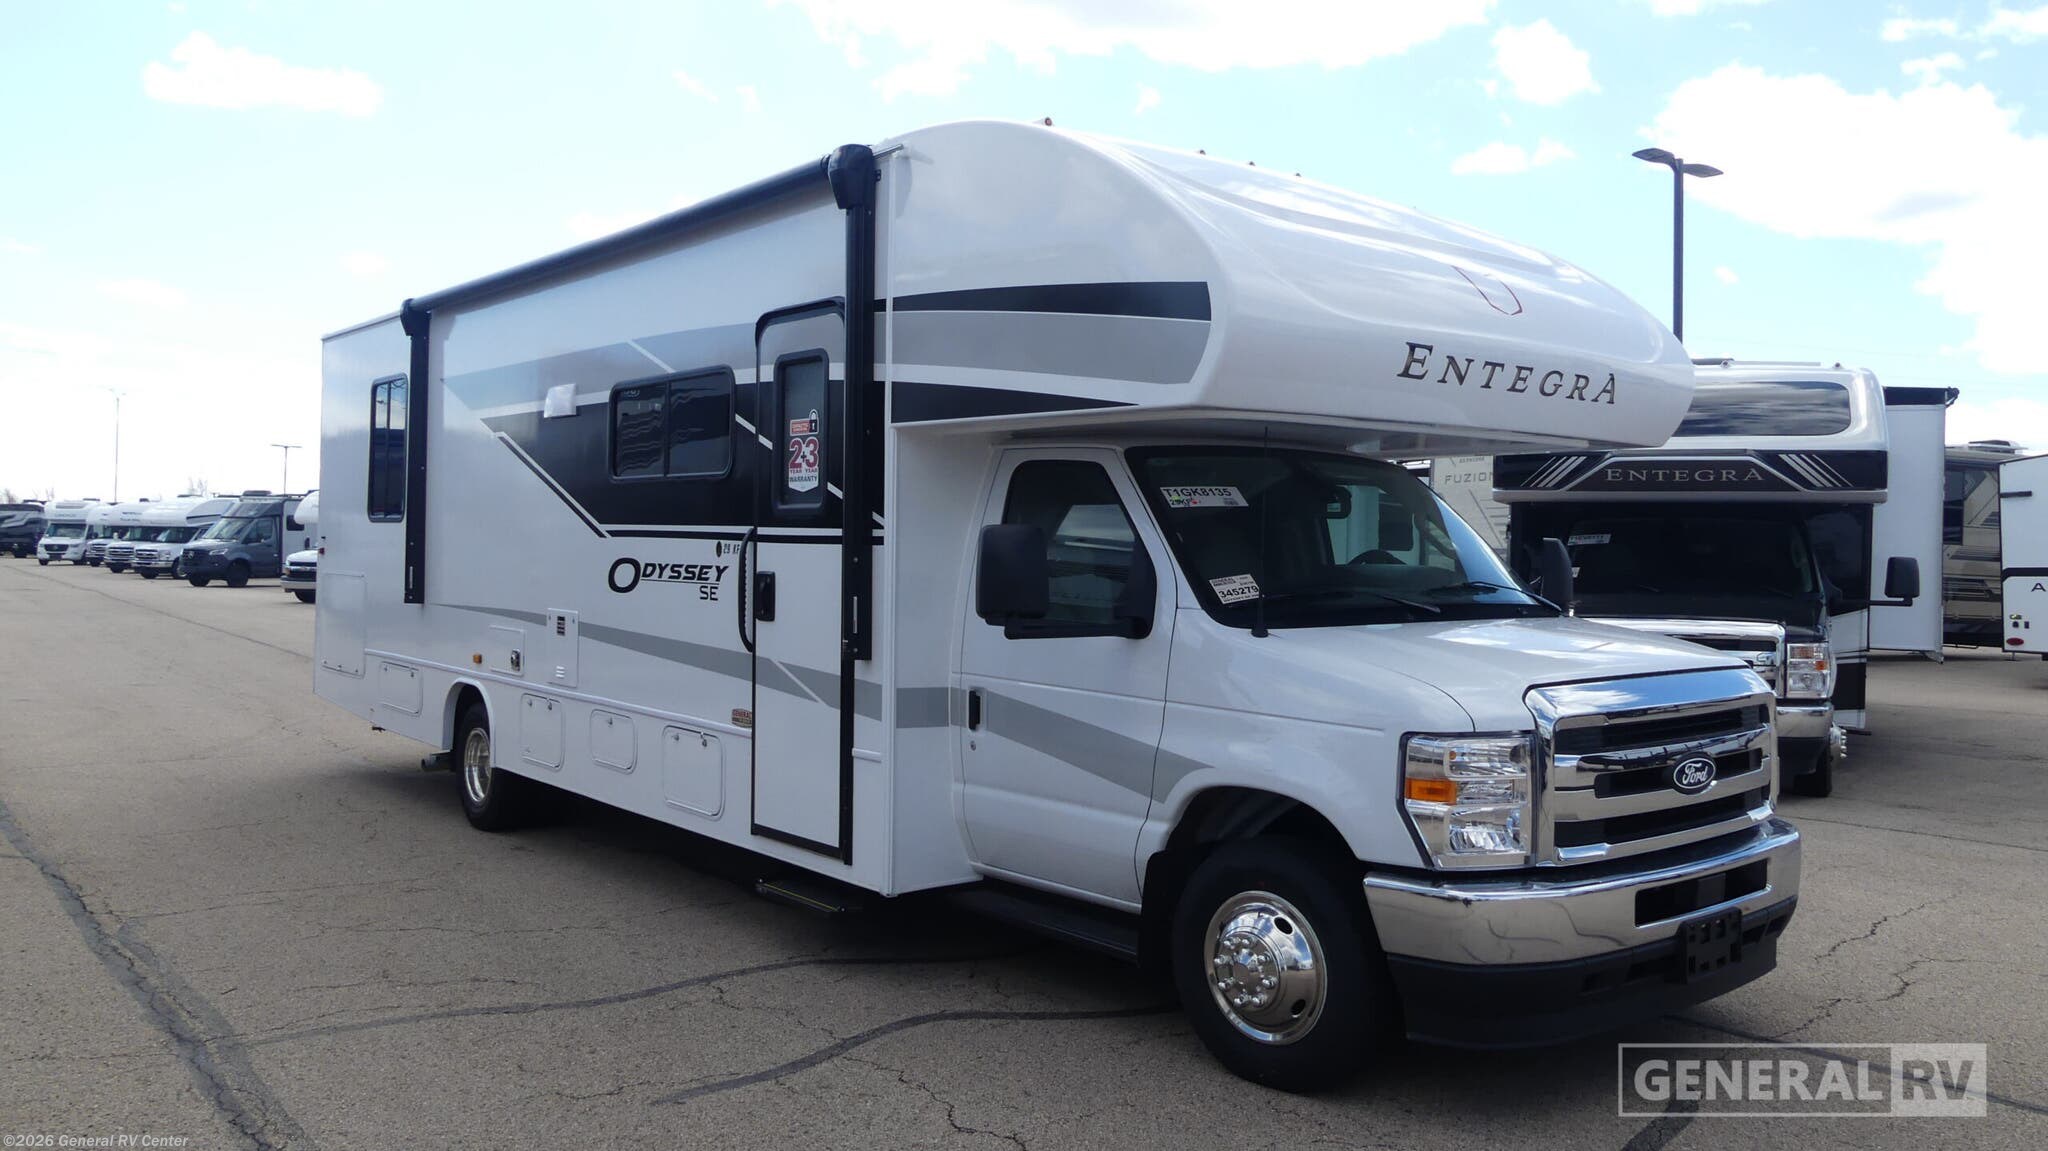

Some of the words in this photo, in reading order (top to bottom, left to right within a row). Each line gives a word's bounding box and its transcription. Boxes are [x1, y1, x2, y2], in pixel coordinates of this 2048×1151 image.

[1396, 341, 1616, 405] ENTEGRA
[1605, 468, 1765, 482] ENTEGRA
[1163, 487, 1232, 498] T1GK8135
[608, 557, 729, 593] ODYSSEY
[699, 585, 719, 601] SE
[1218, 586, 1259, 598] 345279
[1682, 762, 1709, 785] Ford
